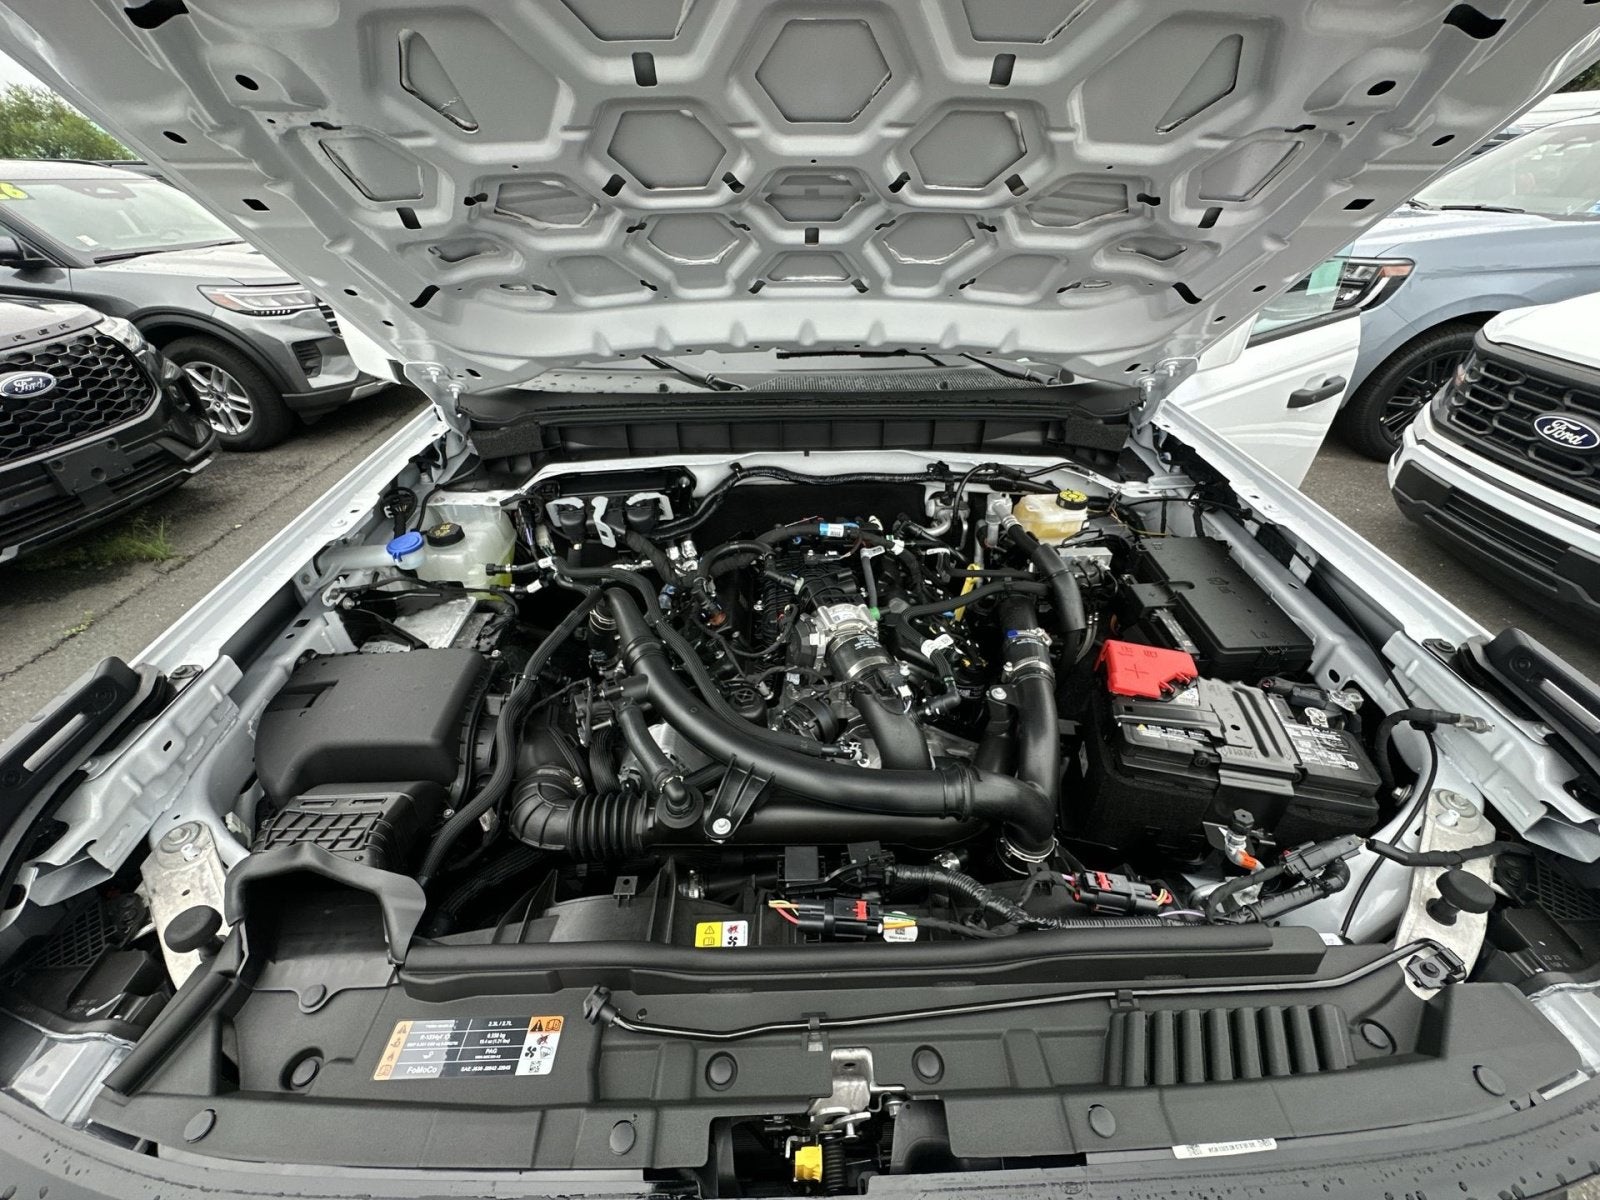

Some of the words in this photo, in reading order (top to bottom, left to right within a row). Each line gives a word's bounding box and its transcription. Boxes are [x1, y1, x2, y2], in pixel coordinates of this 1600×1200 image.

[13, 377, 46, 394] Ford
[1543, 419, 1589, 446] Ford
[407, 1065, 438, 1074] FoMoCo
